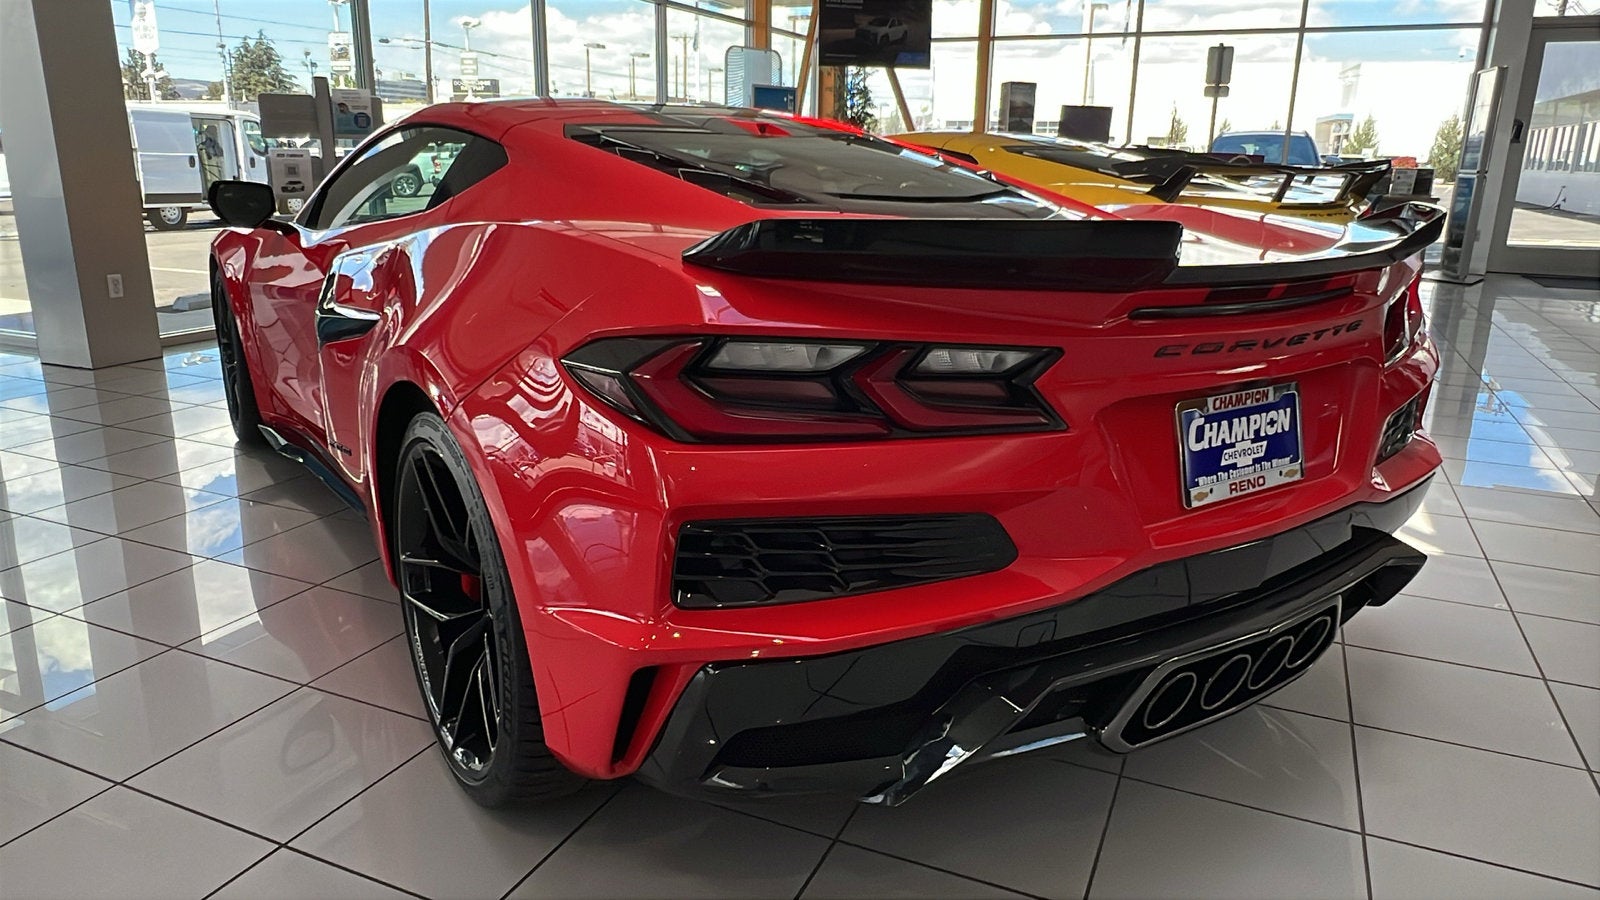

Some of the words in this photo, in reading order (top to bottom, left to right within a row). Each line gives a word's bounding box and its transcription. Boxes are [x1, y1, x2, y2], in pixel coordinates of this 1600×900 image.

[1154, 319, 1363, 358] CORVETTE
[1213, 389, 1269, 411] CHAMPION
[1223, 445, 1264, 462] CHEVROLET
[1229, 475, 1266, 495] RENO
